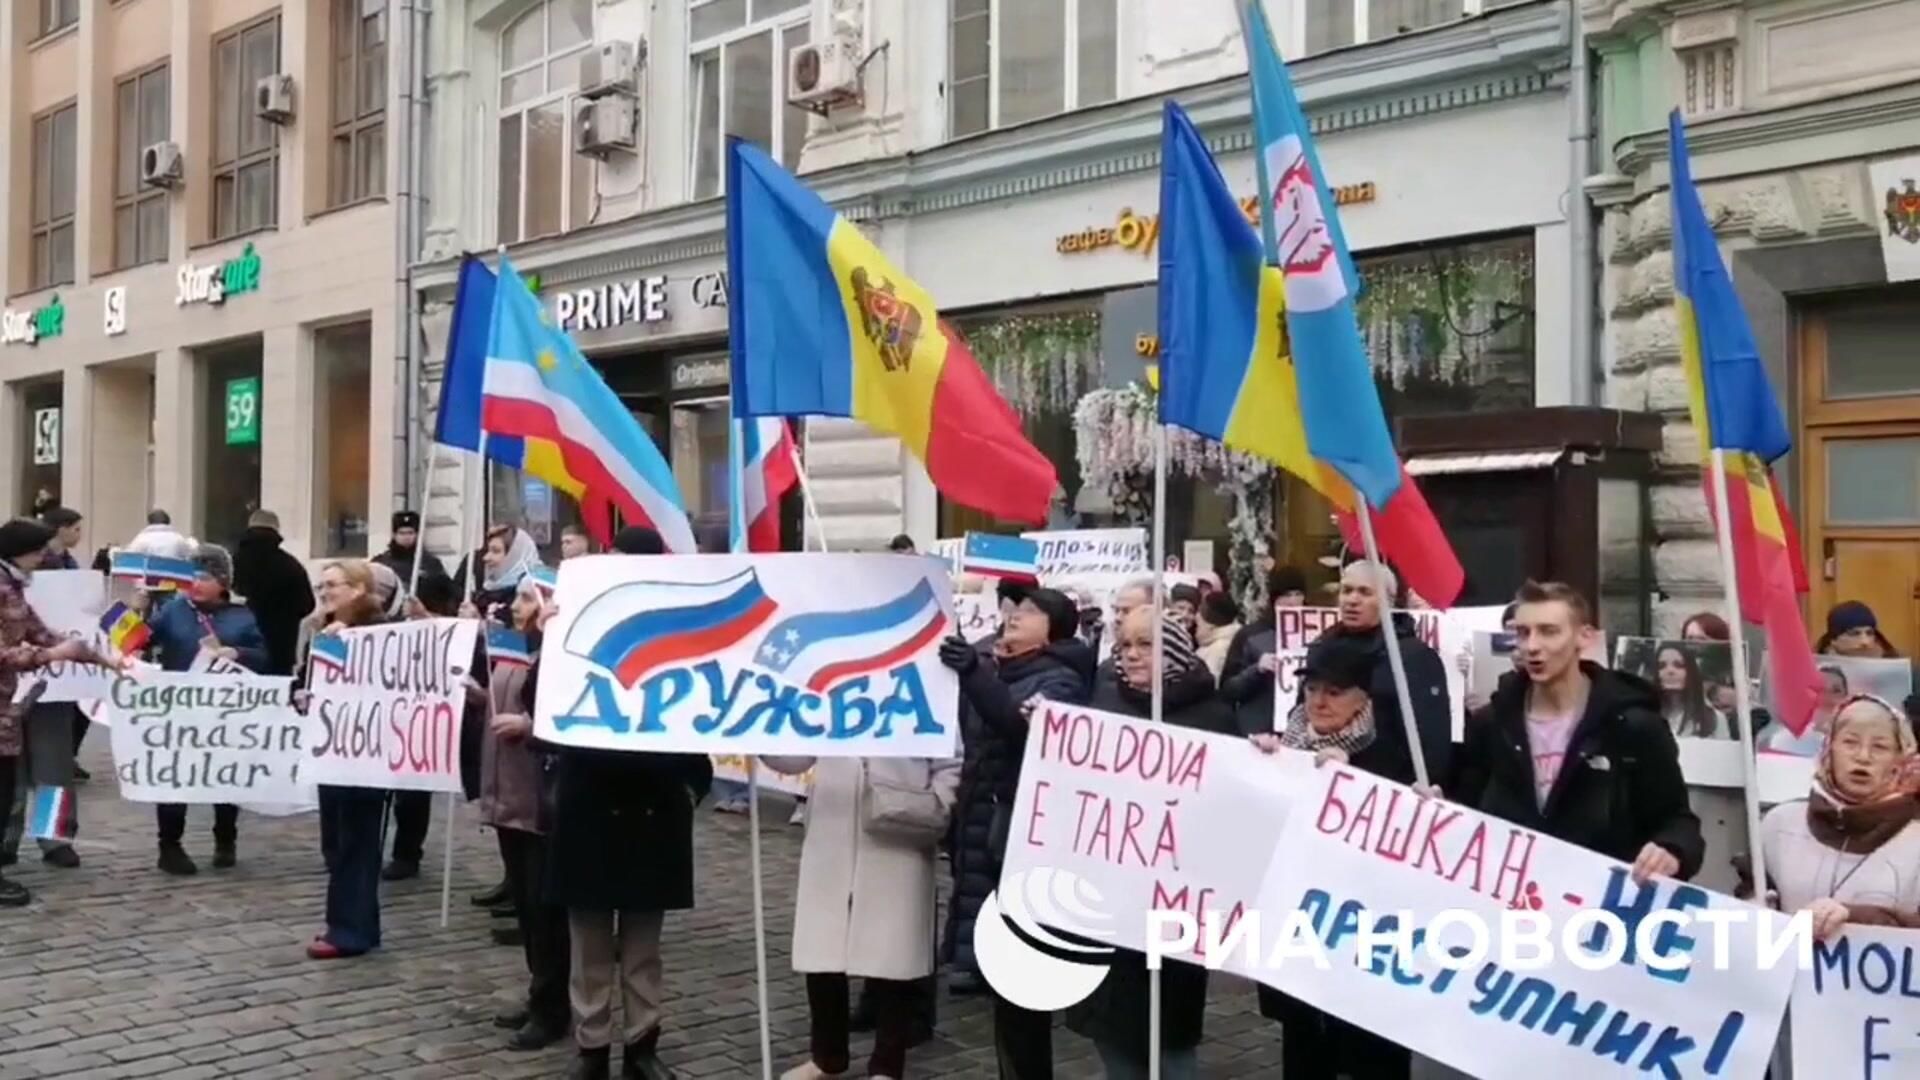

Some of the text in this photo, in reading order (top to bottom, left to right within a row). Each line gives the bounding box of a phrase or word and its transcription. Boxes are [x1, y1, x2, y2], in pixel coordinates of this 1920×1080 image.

[557, 271, 728, 331] PRIME CA
[227, 393, 255, 428] 59
[551, 659, 945, 739] ДРУЖБА
[1041, 712, 1208, 791] MOLDOVA
[1027, 781, 1050, 846] E
[1580, 866, 1709, 983] НЕ
[1812, 936, 1920, 997] MOL
